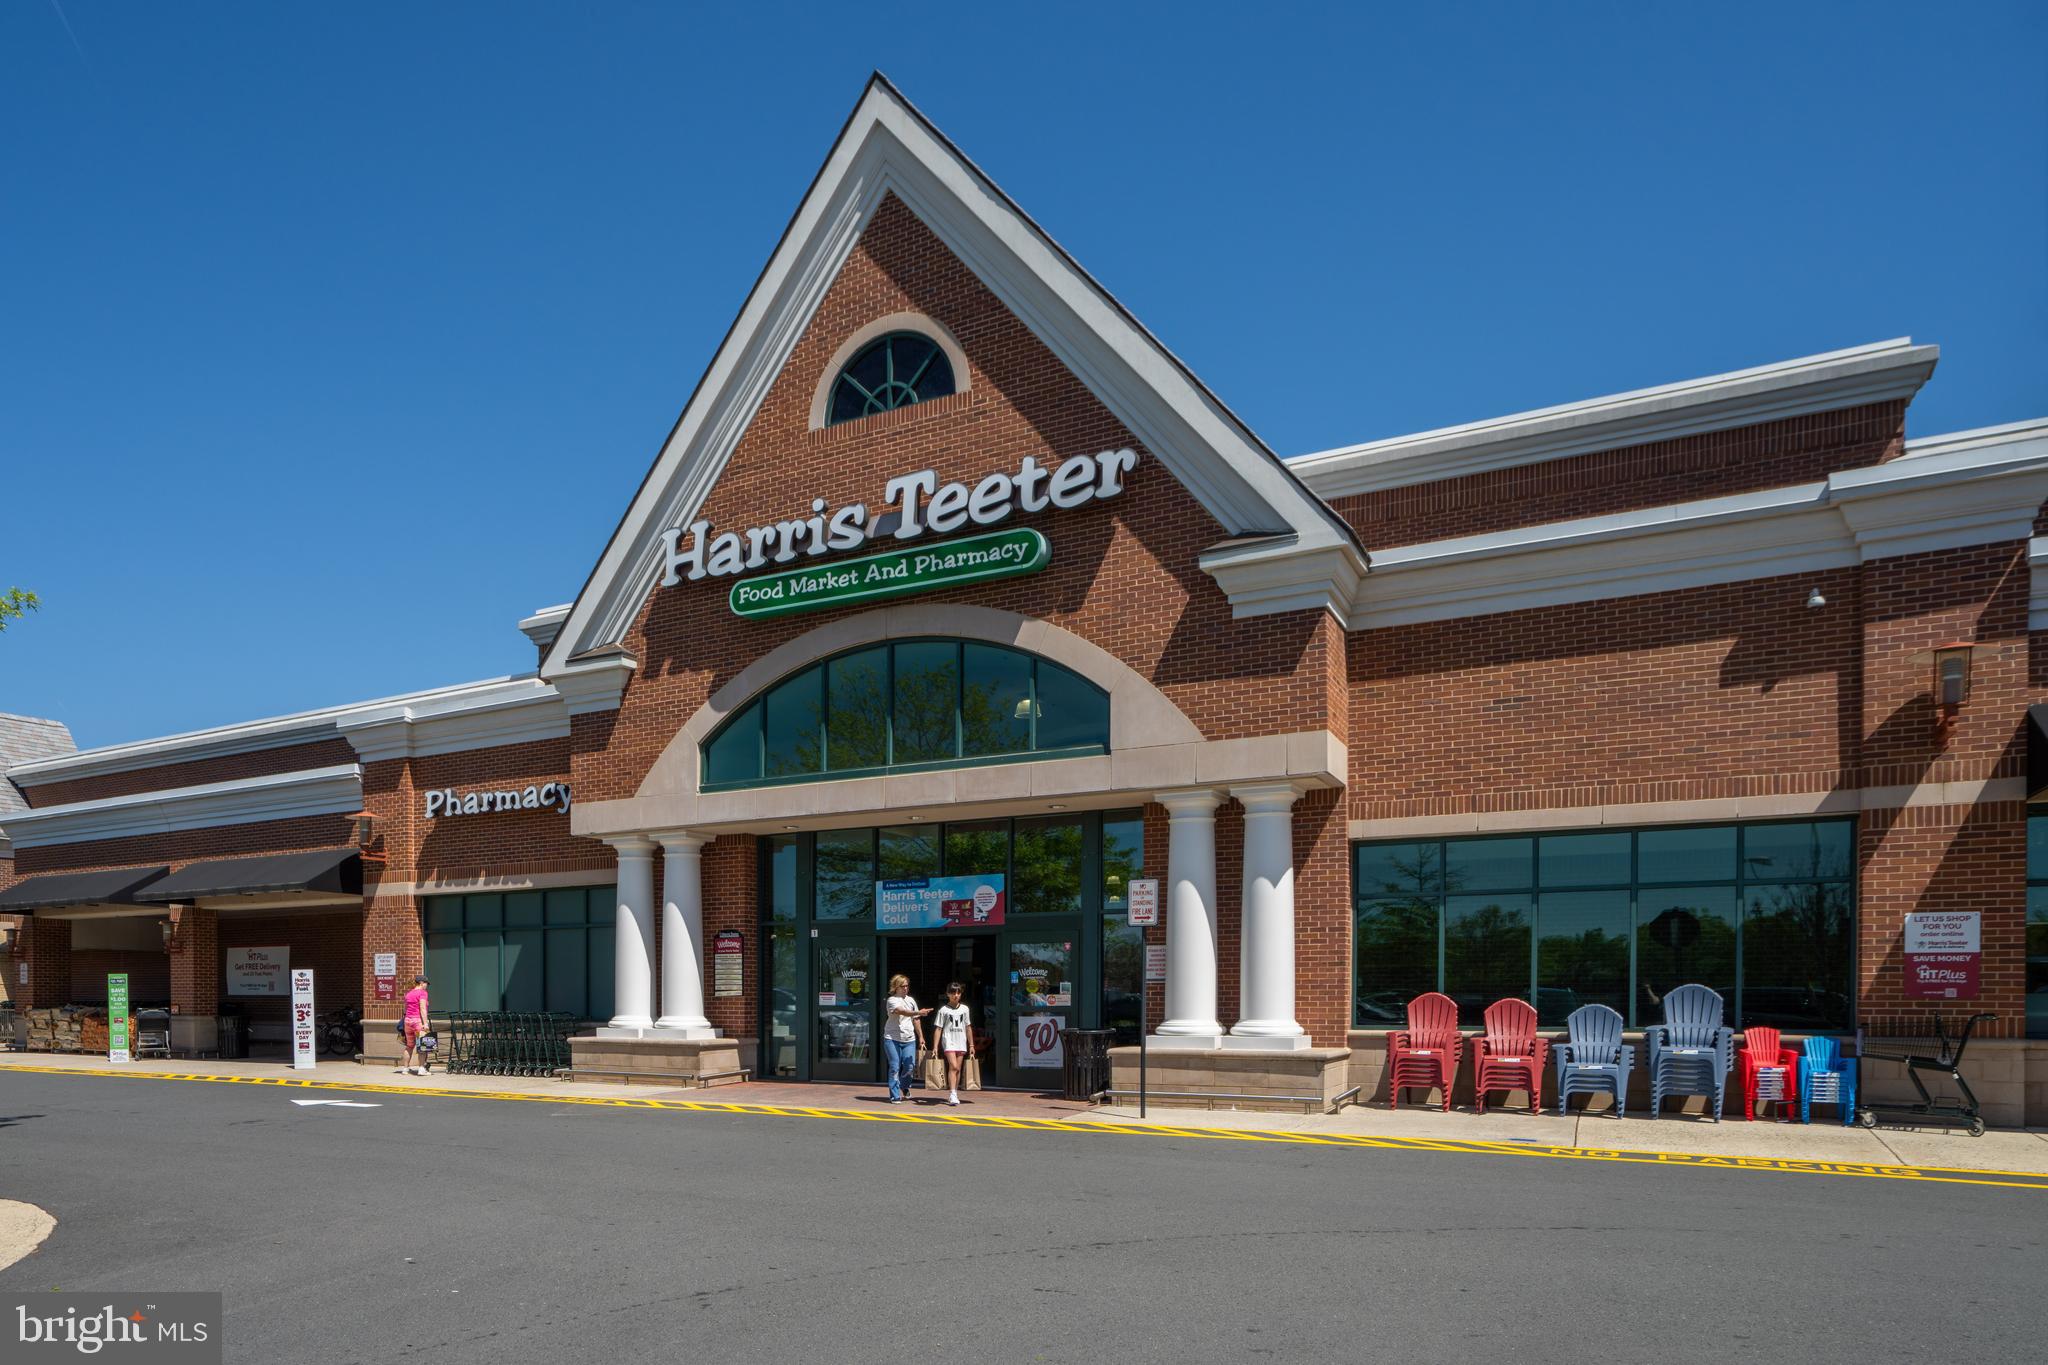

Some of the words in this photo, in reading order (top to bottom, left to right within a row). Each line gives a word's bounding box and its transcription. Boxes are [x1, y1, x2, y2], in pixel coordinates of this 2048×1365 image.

[659, 498, 869, 588] Harris
[885, 447, 1140, 540] Teeter
[738, 582, 785, 605] Food
[789, 569, 859, 597] Market
[863, 560, 909, 584] And
[914, 541, 1030, 575] Pharmacy
[424, 782, 572, 819] Pharmacy
[883, 890, 916, 901] Harris
[917, 888, 955, 899] Teeter
[883, 902, 929, 913] Delivers
[883, 913, 909, 925] Cold
[717, 939, 741, 949] Welcome
[260, 963, 280, 972] Delivery
[1018, 967, 1048, 977] Welcome
[841, 969, 867, 978] Welcome
[1920, 970, 1938, 978] HT
[1938, 970, 1967, 979] Plus
[296, 1010, 311, 1021] 3¢
[1025, 1018, 1058, 1054] W
[1551, 1148, 1620, 1157] NO
[1658, 1154, 1921, 1176] PARKING
